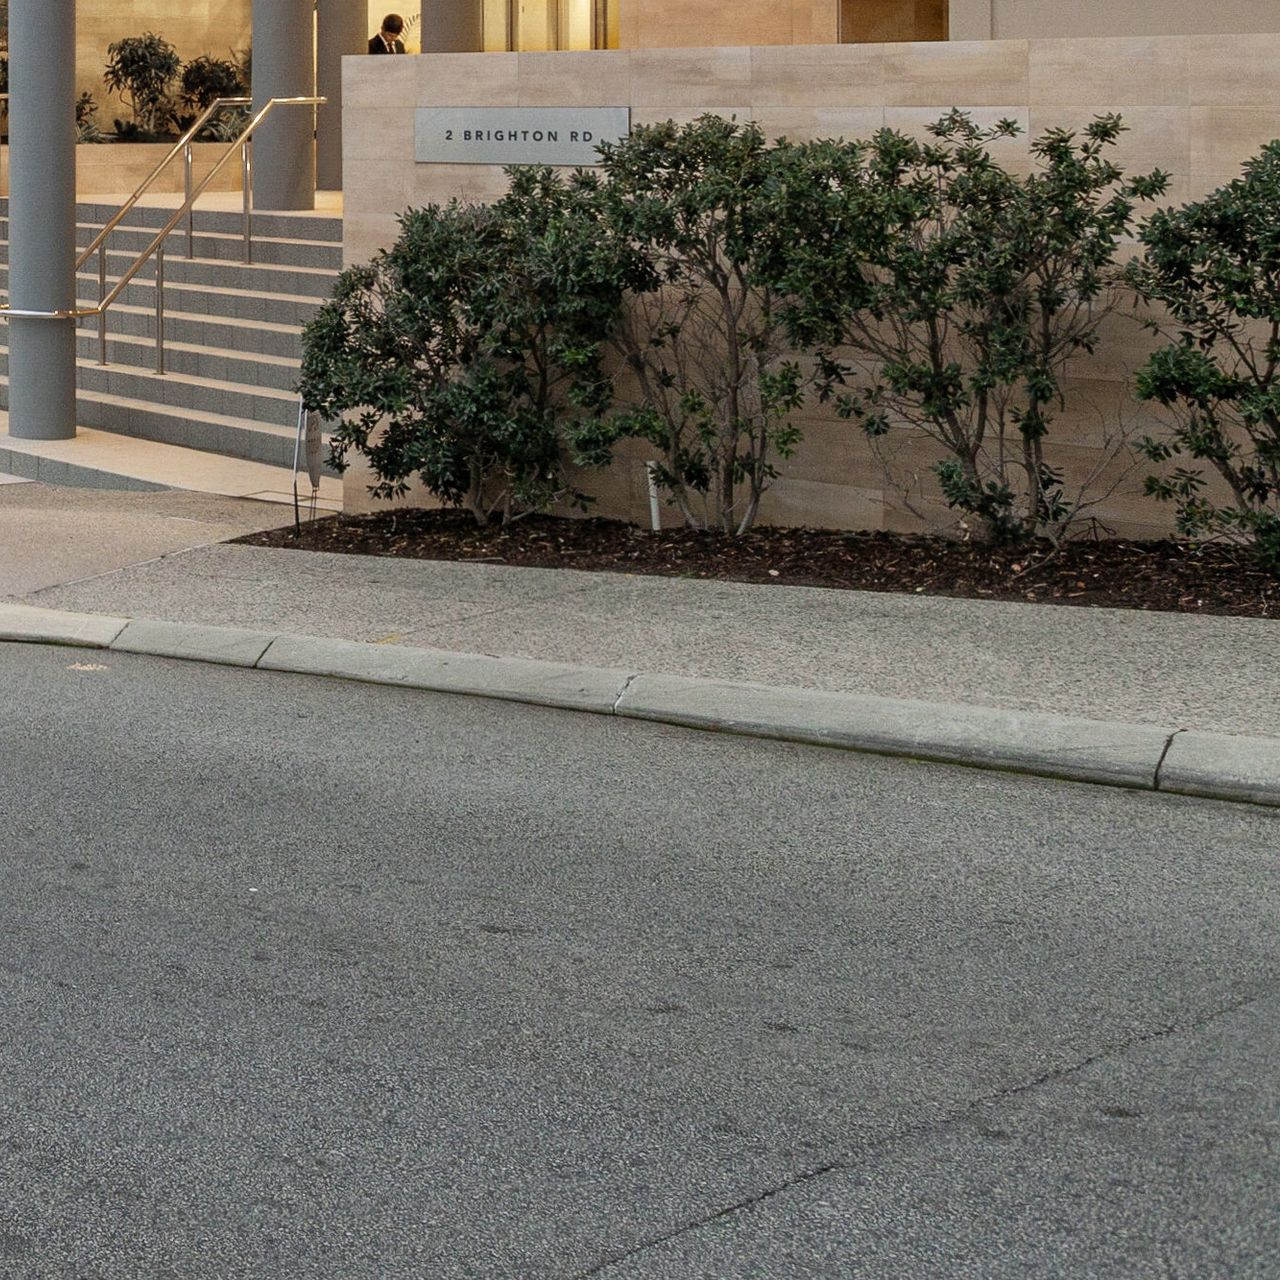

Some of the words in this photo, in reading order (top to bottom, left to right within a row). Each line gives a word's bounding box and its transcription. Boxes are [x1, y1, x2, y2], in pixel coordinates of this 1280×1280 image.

[445, 130, 454, 141] 2
[463, 130, 559, 142] BRIGHTON
[570, 131, 593, 142] RD
